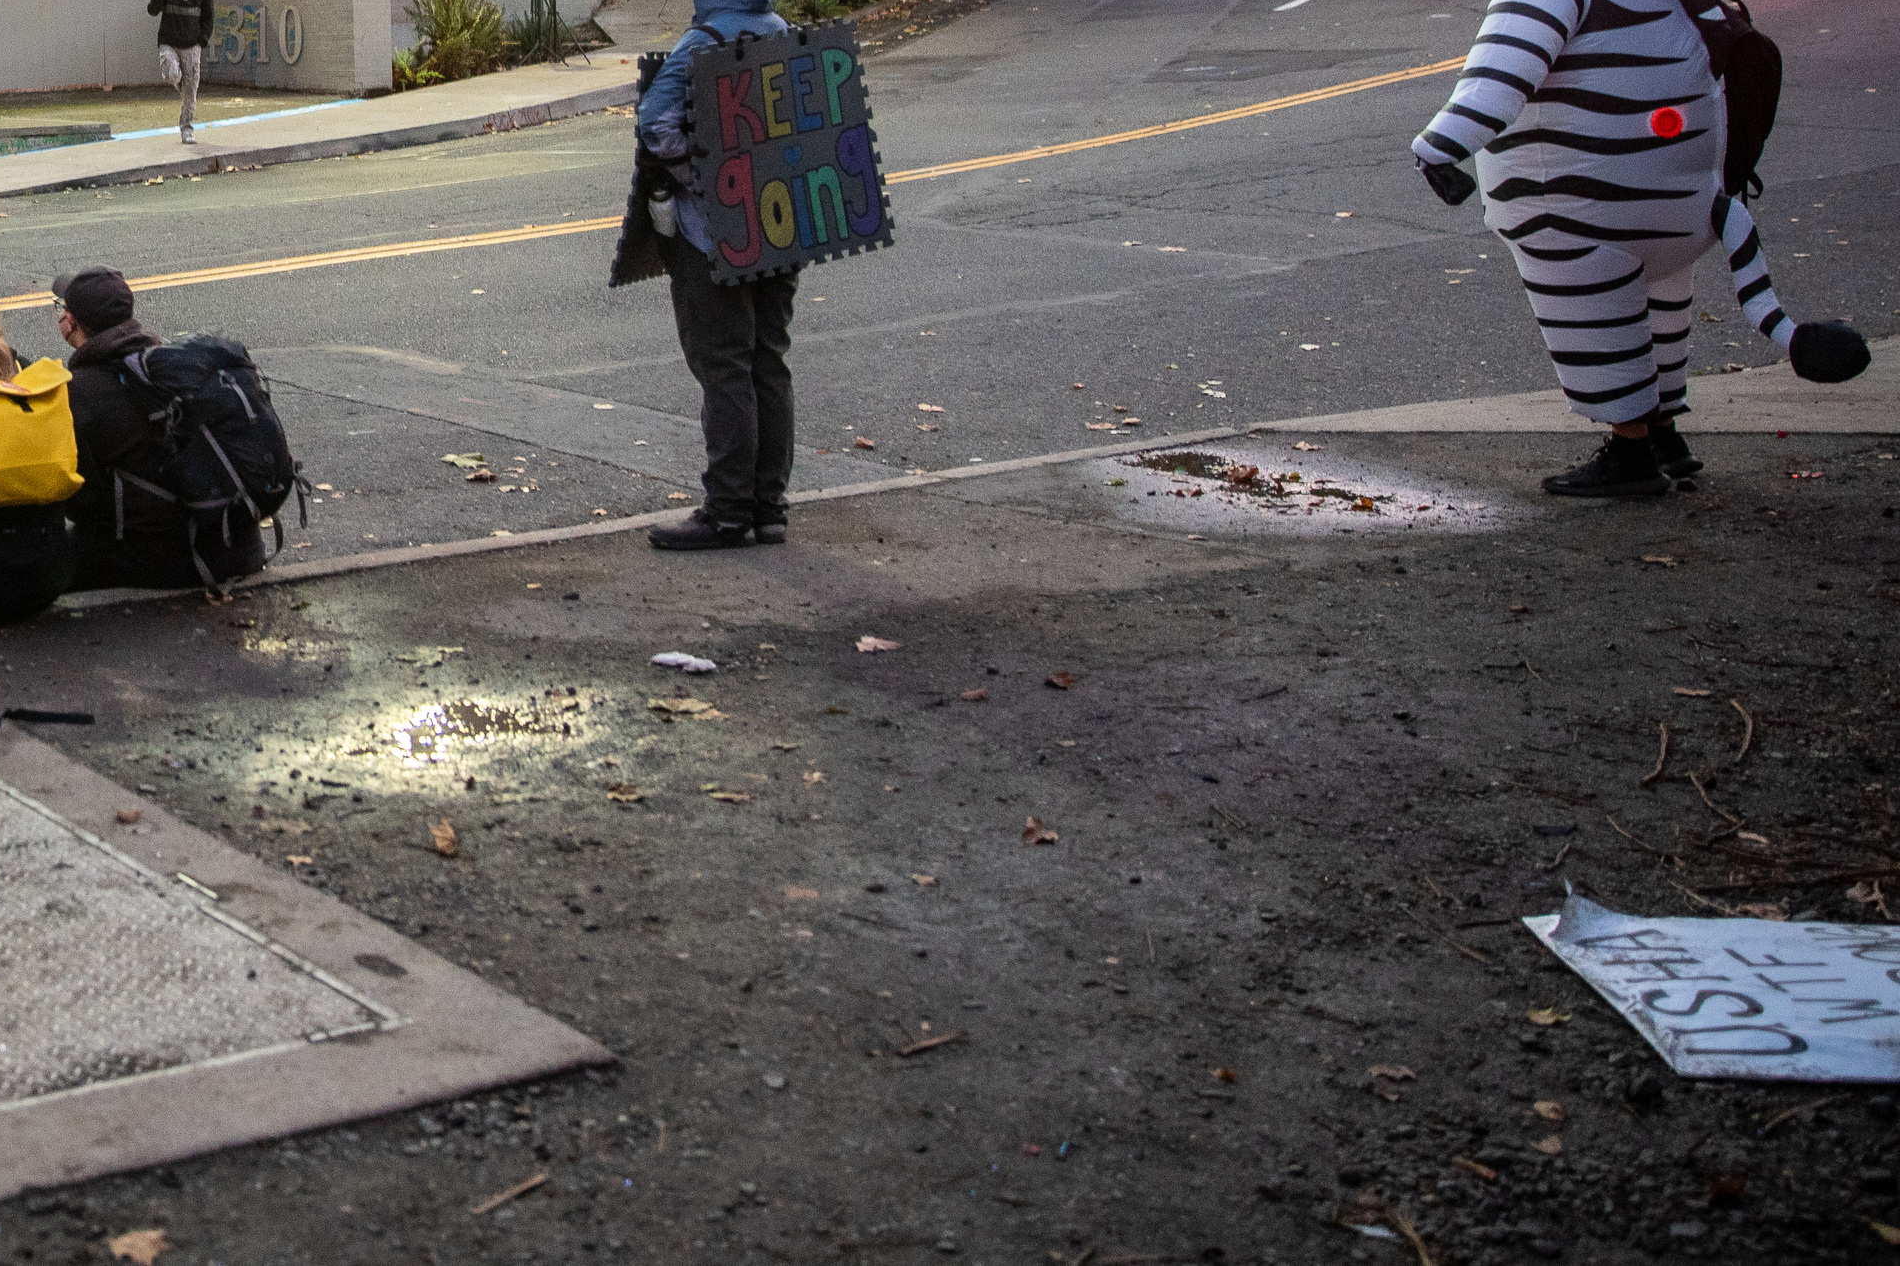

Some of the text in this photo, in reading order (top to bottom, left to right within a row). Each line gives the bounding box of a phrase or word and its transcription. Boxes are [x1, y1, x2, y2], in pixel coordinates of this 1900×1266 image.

[715, 47, 853, 151] KEEP
[715, 123, 882, 268] going
[1573, 928, 1809, 1056] USHA
[1722, 947, 1900, 1024] WTF
